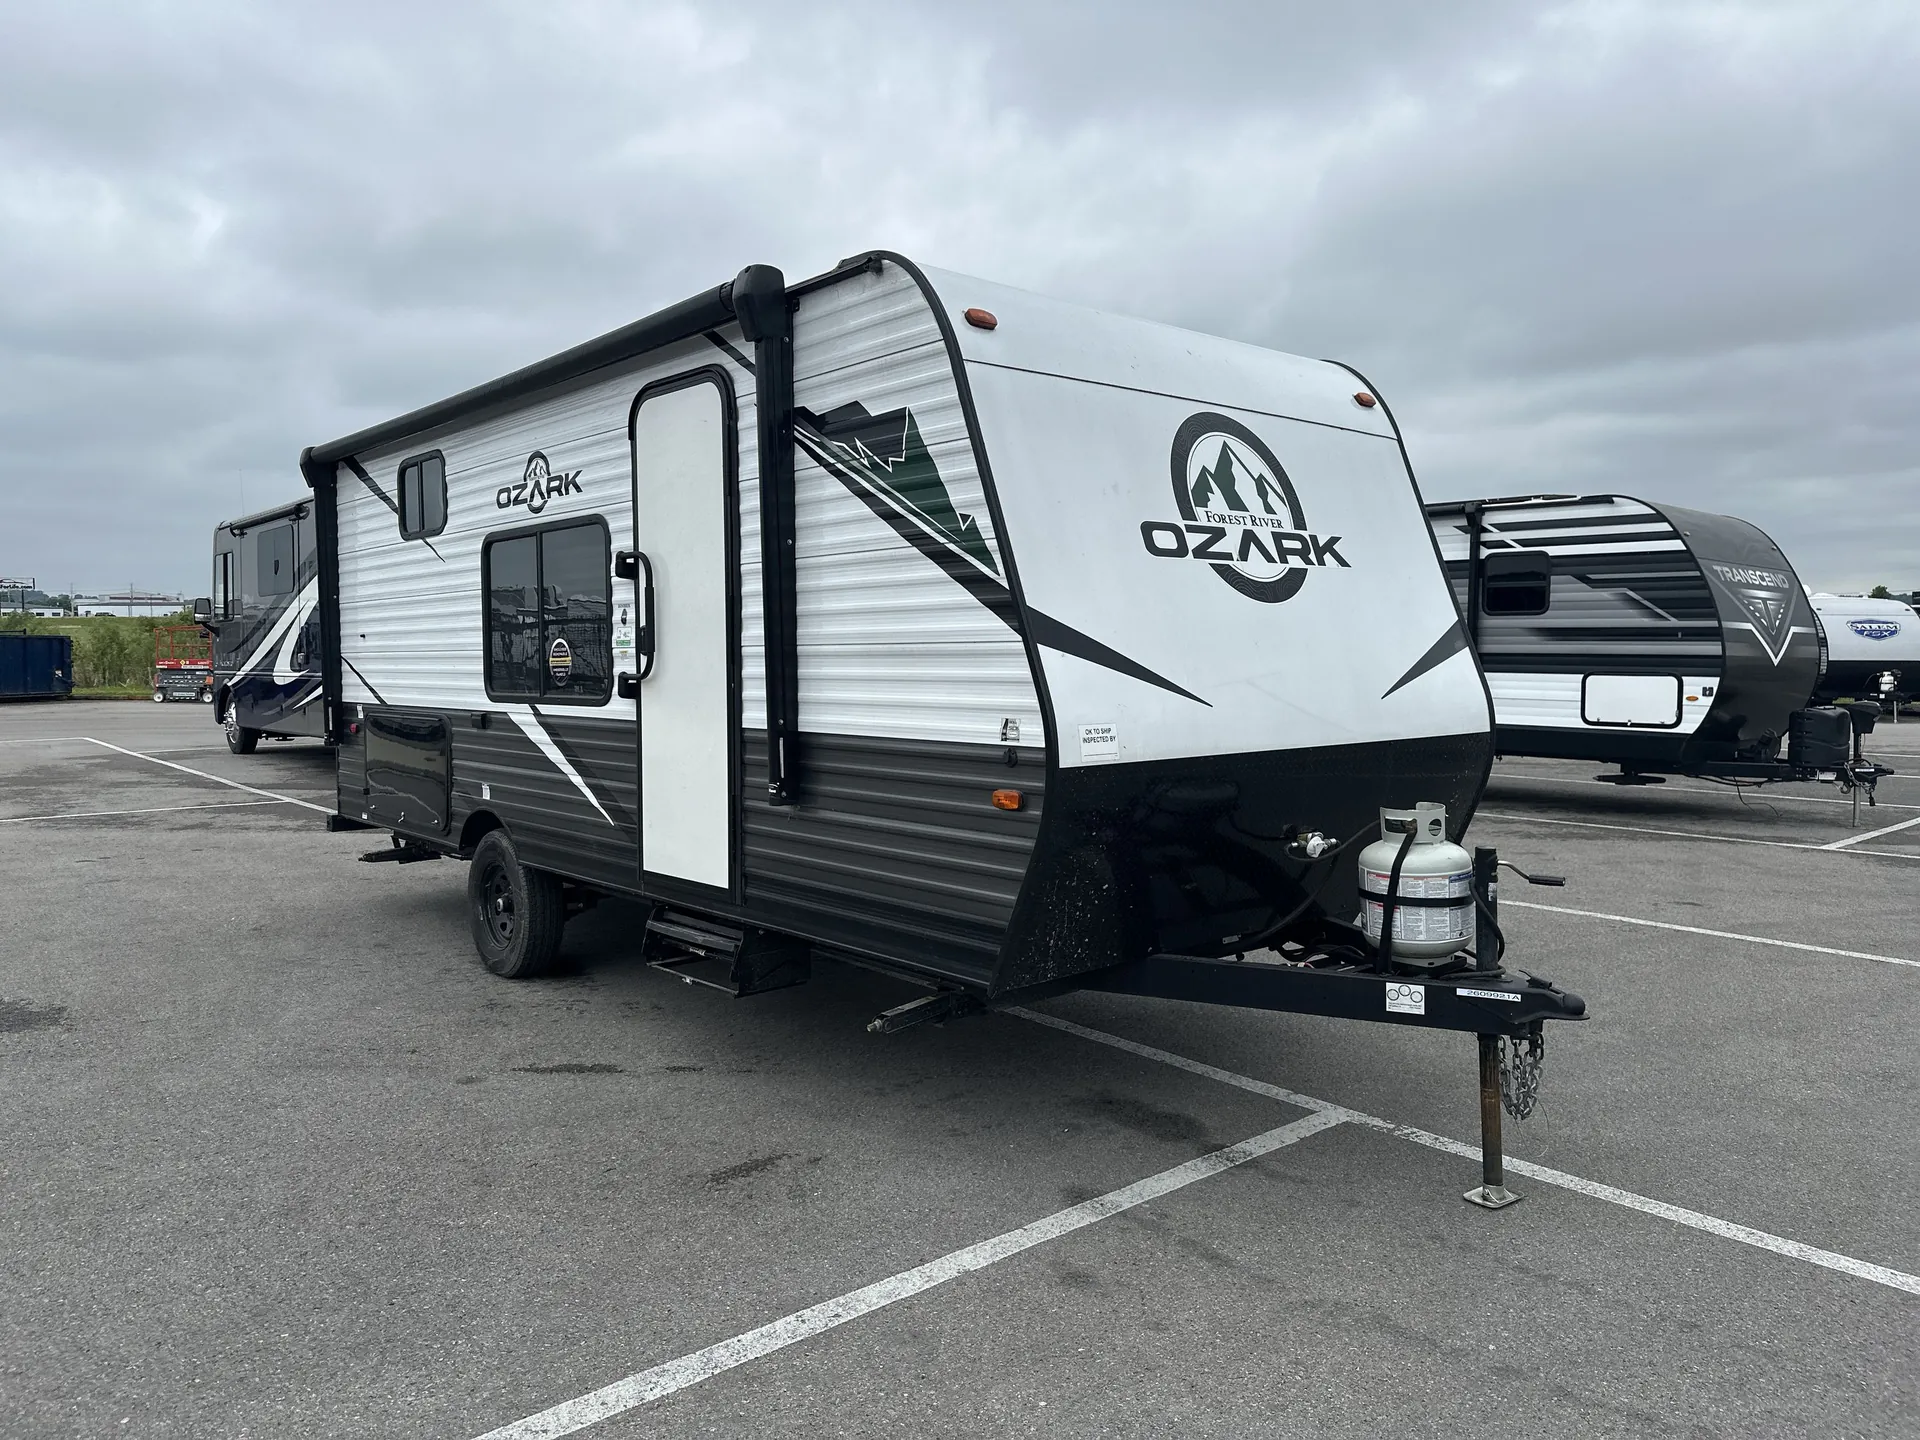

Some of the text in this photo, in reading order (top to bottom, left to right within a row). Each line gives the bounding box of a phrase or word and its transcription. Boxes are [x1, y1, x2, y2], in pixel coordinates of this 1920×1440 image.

[496, 469, 583, 509] OZARK
[1204, 510, 1284, 529] FOREST RIVER
[1140, 520, 1352, 568] OZARK
[1712, 565, 1789, 588] TRANSCEND
